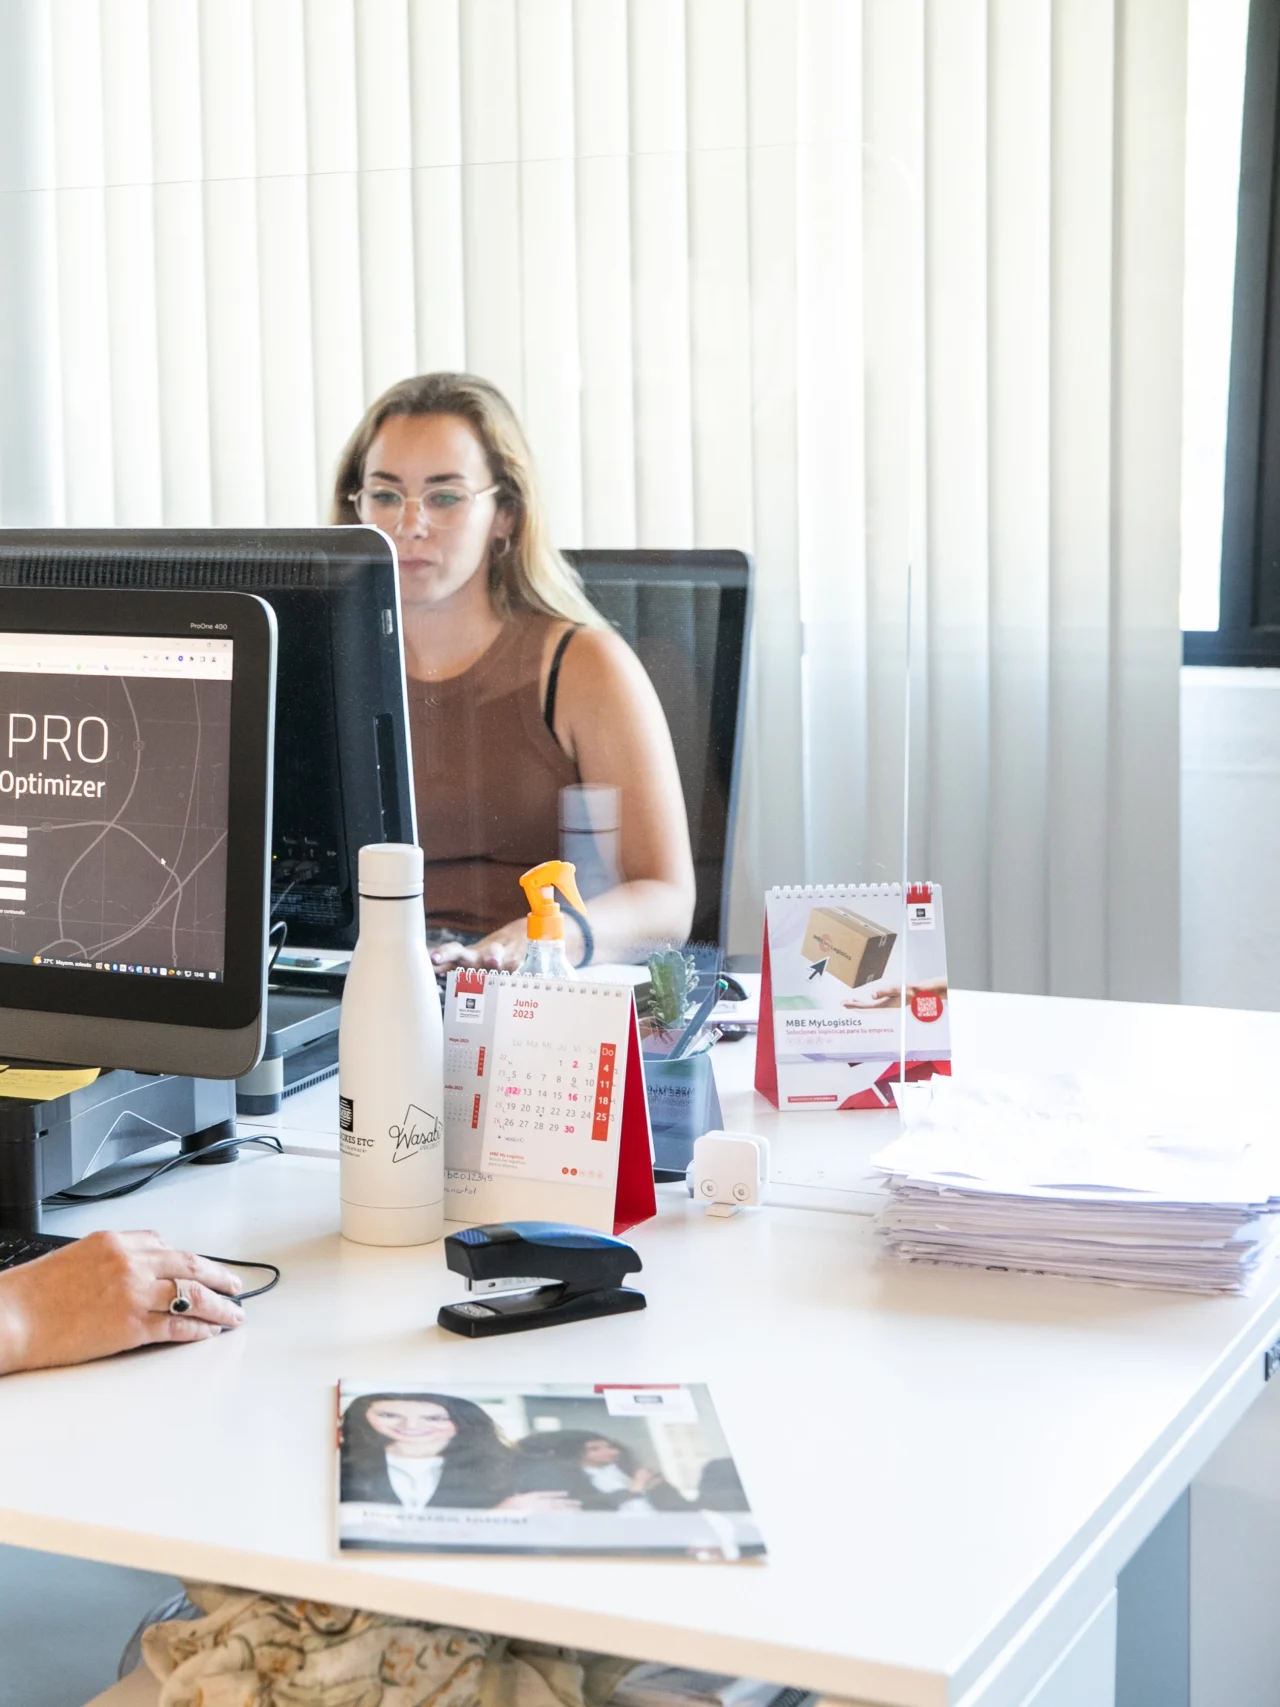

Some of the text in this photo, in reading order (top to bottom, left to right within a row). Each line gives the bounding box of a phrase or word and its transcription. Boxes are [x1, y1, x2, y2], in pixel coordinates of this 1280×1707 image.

[8, 713, 109, 764] PRO
[513, 999, 539, 1009] Junio
[513, 1009, 534, 1019] 2023
[786, 1018, 862, 1028] MBE MyLogistics
[512, 1038, 522, 1047] Lu
[526, 1040, 538, 1048] Ma
[542, 1041, 552, 1049] Mi
[587, 1047, 598, 1055] Sa
[601, 1047, 614, 1057] Do
[588, 1062, 594, 1070] 3
[585, 1079, 595, 1087] 10
[508, 1087, 518, 1095] 12
[523, 1088, 532, 1096] 13
[538, 1090, 547, 1098] 14
[568, 1093, 578, 1101] 16
[583, 1095, 593, 1103] 17
[598, 1097, 609, 1105] 18
[520, 1104, 531, 1112] 20
[550, 1107, 561, 1115] 22
[565, 1109, 576, 1117] 23
[580, 1111, 591, 1119] 24
[596, 1112, 607, 1121] 25
[504, 1119, 514, 1127] 26
[519, 1120, 529, 1128] 27
[534, 1122, 544, 1130] 28
[548, 1124, 559, 1132] 29
[564, 1125, 575, 1133] 30
[444, 1171, 493, 1182] be012345
